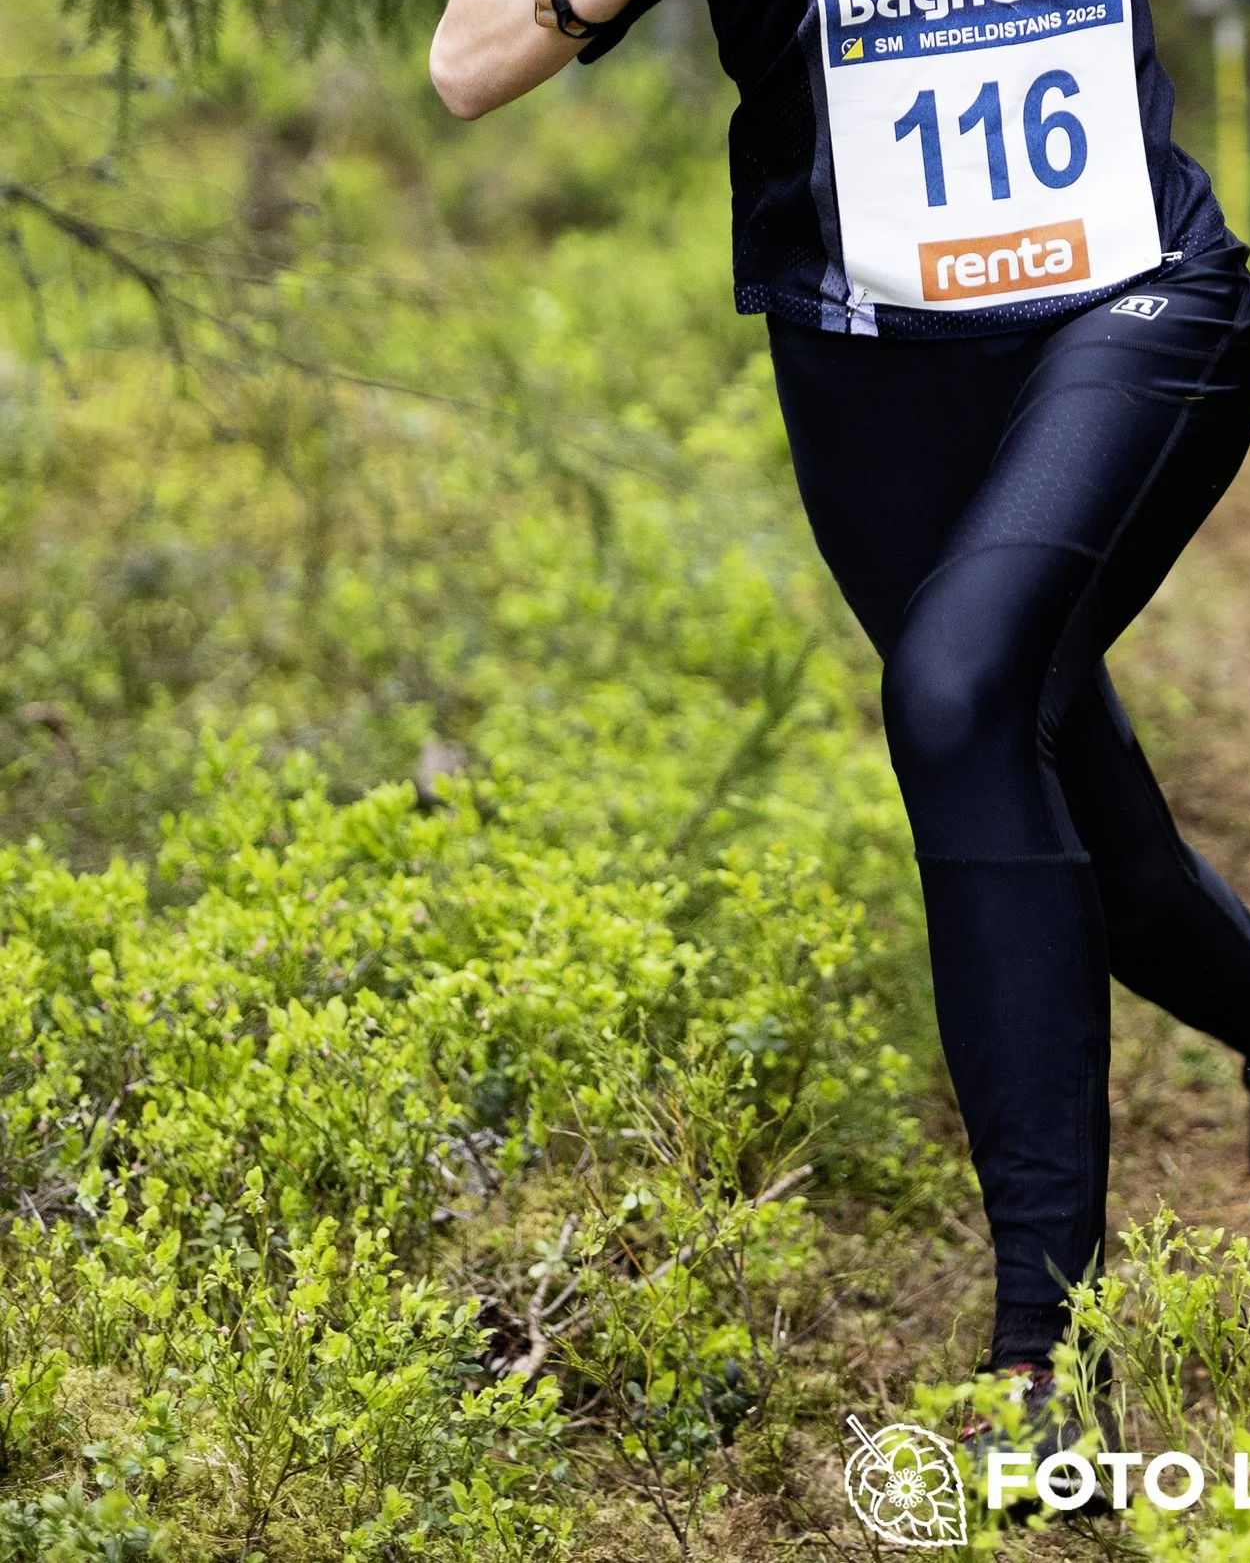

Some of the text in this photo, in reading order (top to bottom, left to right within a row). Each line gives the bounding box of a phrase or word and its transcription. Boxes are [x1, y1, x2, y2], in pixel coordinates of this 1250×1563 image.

[875, 4, 1107, 53] SM MEDELDISTANS 2025
[893, 69, 1088, 207] 116
[936, 235, 1073, 291] renta
